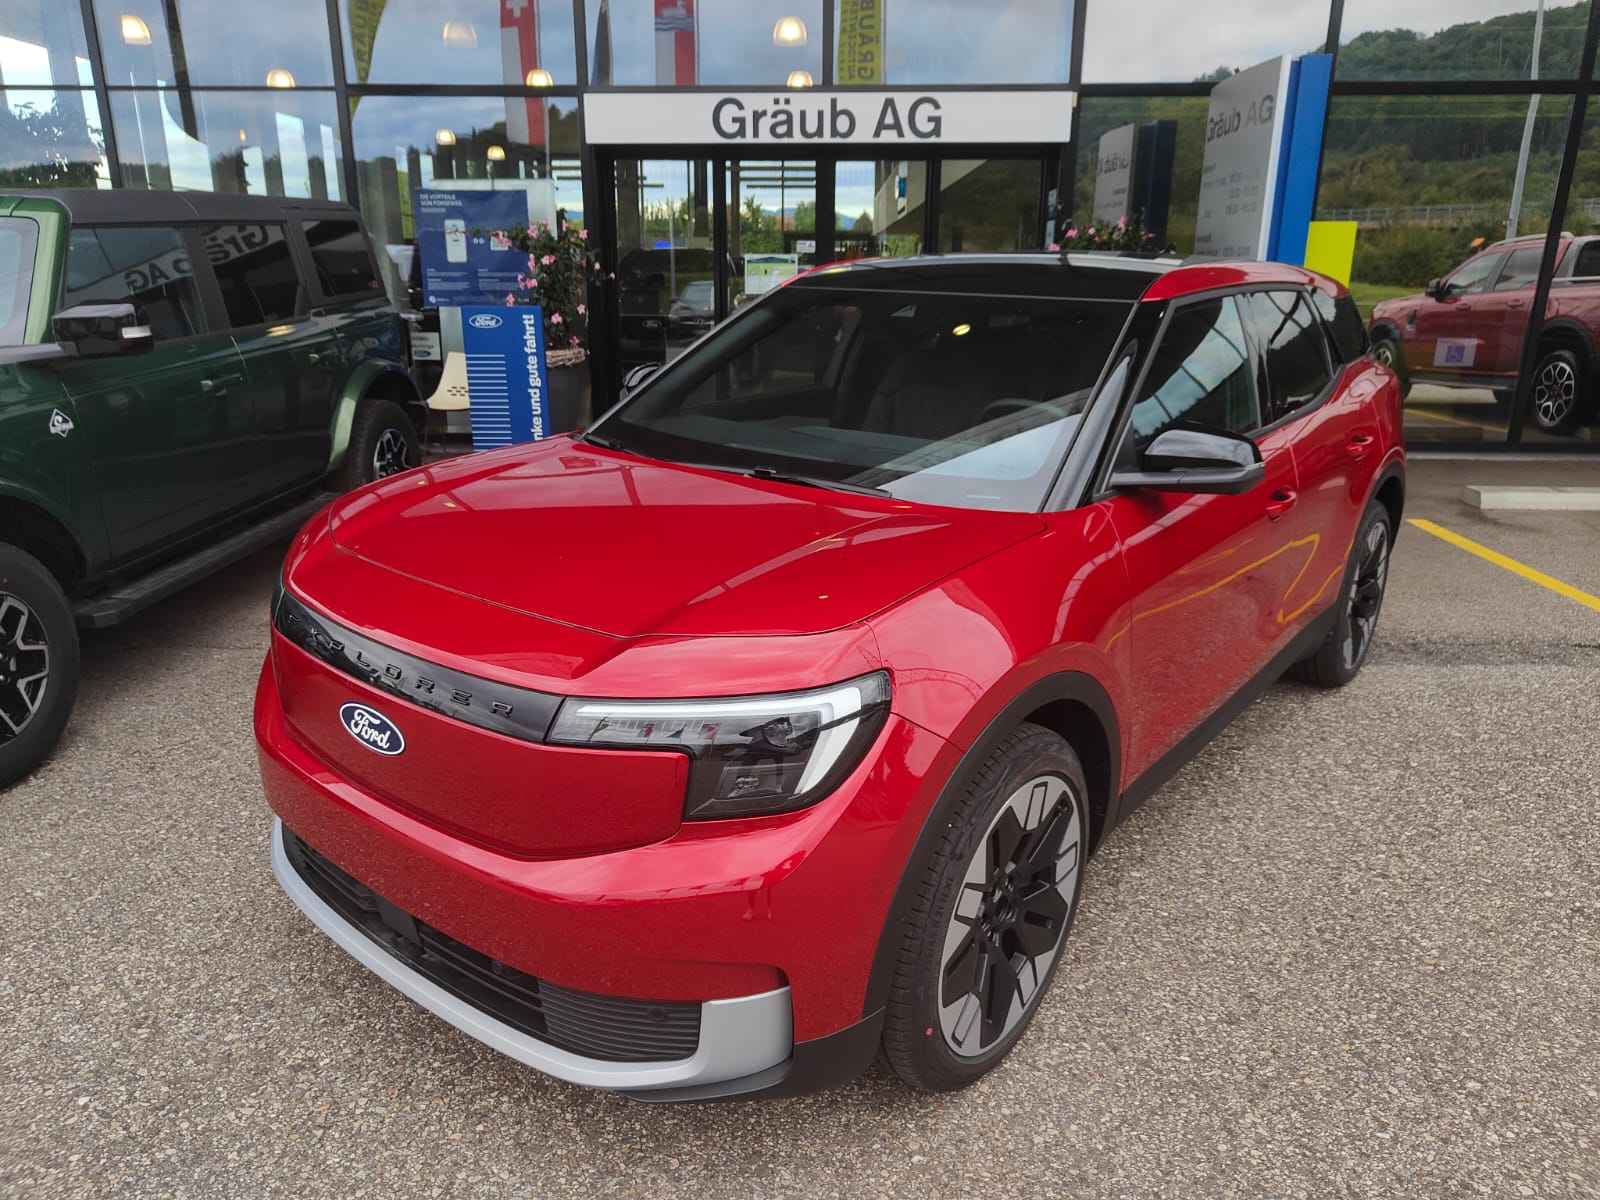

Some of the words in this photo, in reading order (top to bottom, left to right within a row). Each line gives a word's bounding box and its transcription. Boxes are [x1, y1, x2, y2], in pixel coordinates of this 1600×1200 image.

[711, 96, 857, 140] Gräub
[872, 96, 943, 140] AG
[1245, 94, 1275, 129] AG
[472, 315, 499, 327] Ford
[522, 314, 537, 354] fahrt!
[526, 355, 541, 388] gute
[527, 388, 541, 415] und
[288, 613, 514, 719] EXPLORER
[348, 707, 392, 750] Ford
